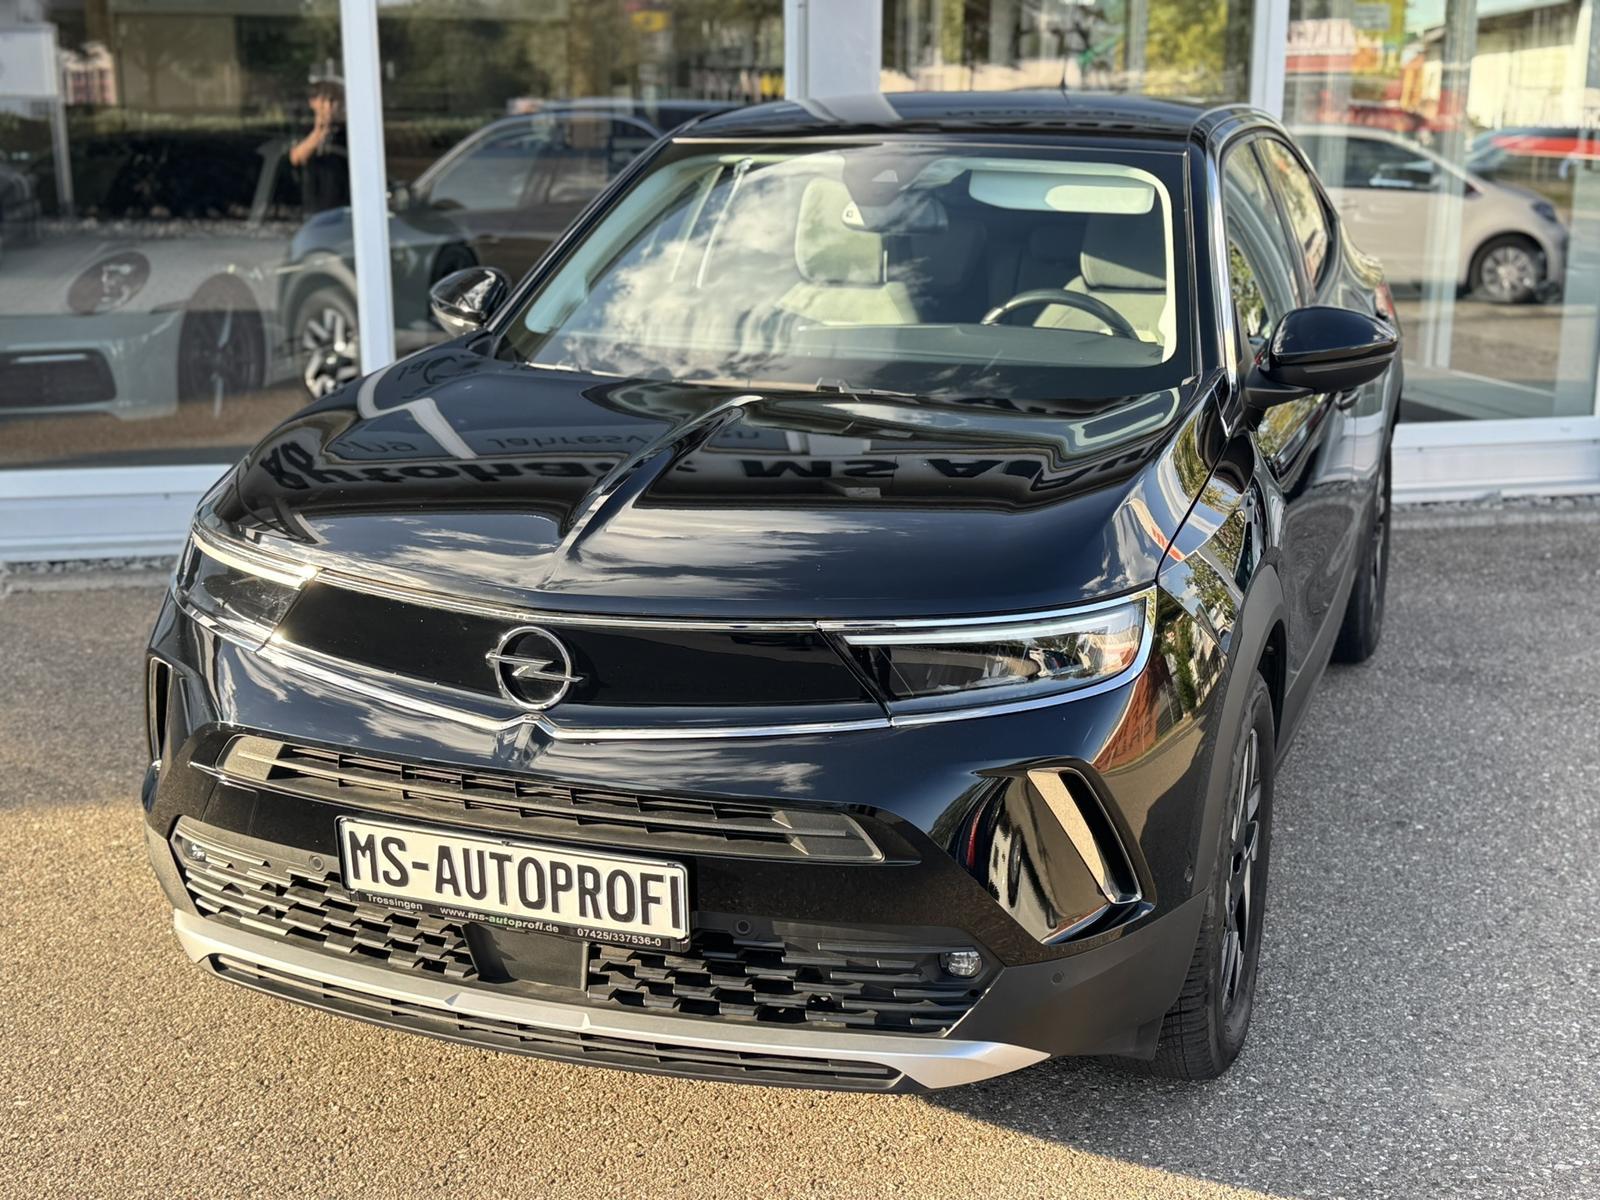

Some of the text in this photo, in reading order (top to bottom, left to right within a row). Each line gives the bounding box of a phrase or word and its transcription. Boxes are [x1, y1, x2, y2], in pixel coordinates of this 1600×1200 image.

[348, 830, 682, 929] MS-AUTOPROFI
[367, 893, 662, 948] Trossingen www.ms-autoprofi.de 07425/337536-0
